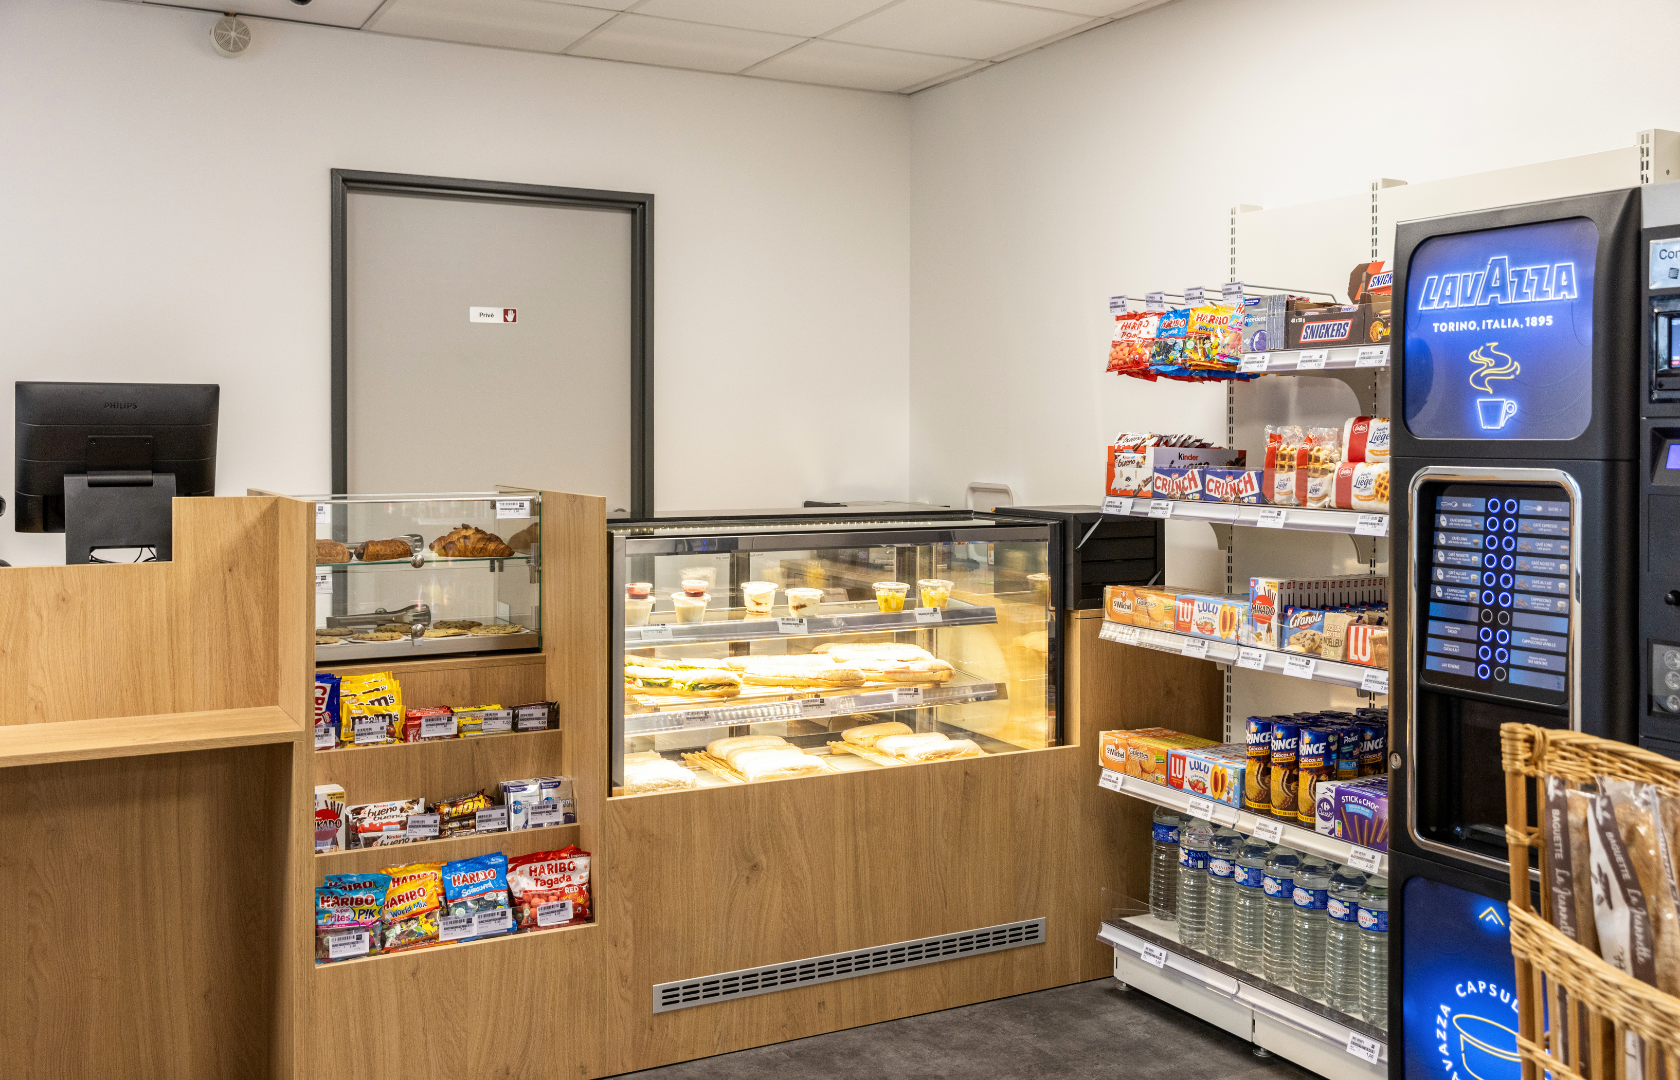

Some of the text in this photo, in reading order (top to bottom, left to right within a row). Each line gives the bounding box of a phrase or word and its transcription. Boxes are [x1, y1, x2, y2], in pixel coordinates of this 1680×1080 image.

[1370, 272, 1392, 288] SNICK
[1418, 255, 1578, 310] LAVAZZA
[1303, 322, 1350, 340] SNICKERS
[1433, 316, 1553, 332] TORINO, ITALIA, 1895
[1178, 452, 1199, 461] Kinder
[1154, 469, 1199, 496] CRUNCH
[1206, 471, 1255, 497] CRUNCH
[1178, 602, 1191, 623] LU
[1197, 602, 1218, 615] LULU
[1289, 611, 1323, 629] Granola
[1349, 625, 1374, 662] LU
[1271, 735, 1298, 751] RINCE
[1299, 742, 1327, 756] RINCE
[1171, 756, 1184, 778] LU
[1189, 760, 1210, 775] LULU
[367, 806, 398, 817] bueno
[452, 795, 485, 817] LION
[1341, 795, 1359, 803] STICK
[1362, 798, 1380, 812] CHOC
[1552, 809, 1563, 860] BAGUETTE
[452, 868, 497, 887] HARIBO
[528, 861, 576, 877] HARIBO
[534, 874, 573, 889] Tagada
[564, 885, 579, 894] RED
[320, 894, 376, 908] HARIBO
[383, 887, 427, 910] HARIBO
[1605, 831, 1631, 881] BAGUETTE
[1630, 905, 1652, 965] Jeannette
[322, 913, 351, 922] Frites
[390, 899, 428, 918] World Mix
[1552, 886, 1575, 938] Jeannett
[1455, 980, 1518, 1013] CAPSUL
[1436, 1004, 1461, 1080] AVAZZA
